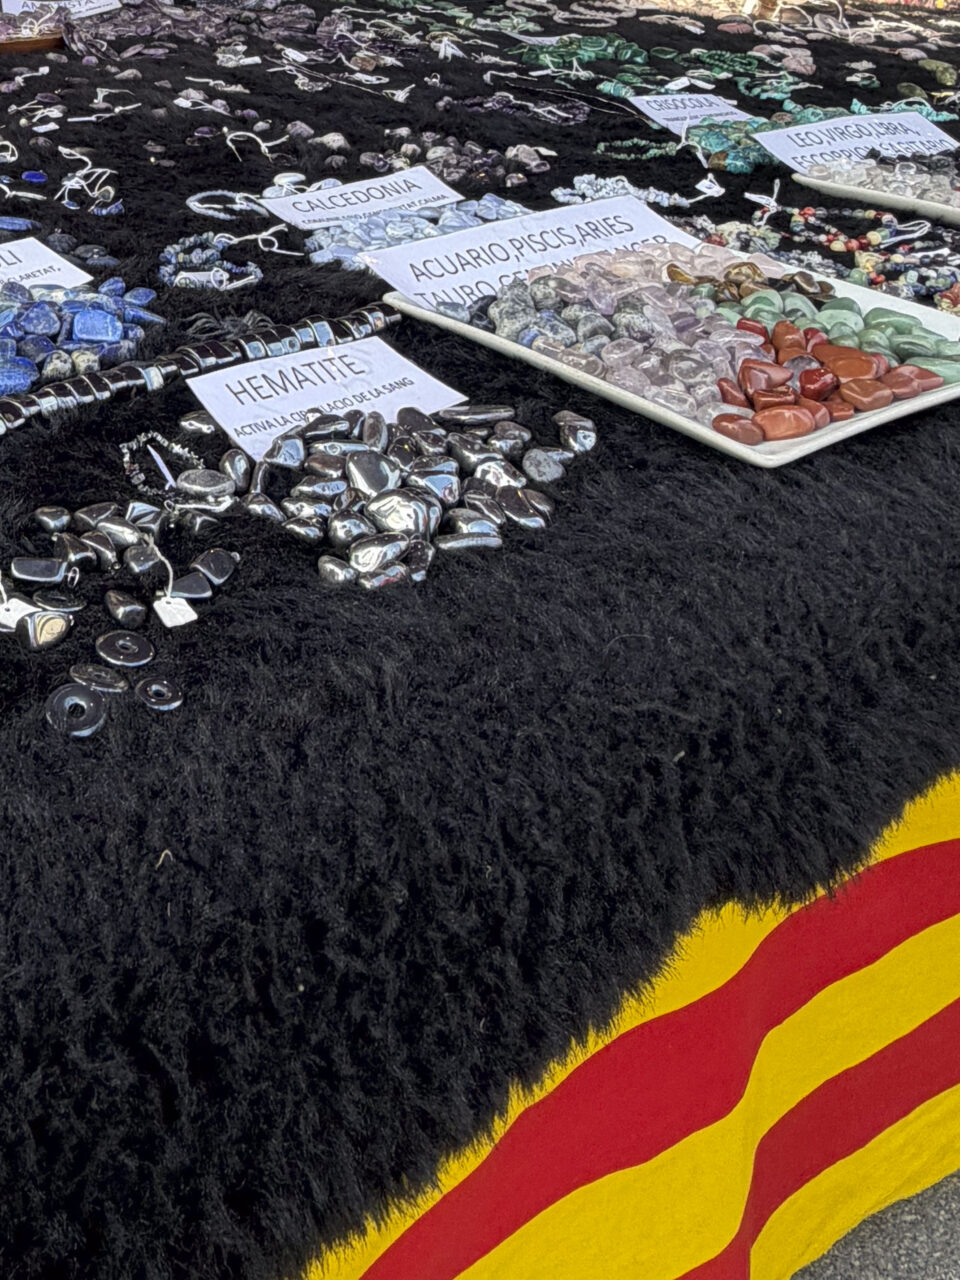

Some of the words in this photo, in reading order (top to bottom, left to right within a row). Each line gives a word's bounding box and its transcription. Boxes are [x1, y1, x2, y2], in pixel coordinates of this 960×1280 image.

[292, 178, 422, 213] CALCEDONIA
[225, 354, 366, 406] HEMATITE
[352, 393, 370, 404] DE
[383, 377, 415, 393] SANG
